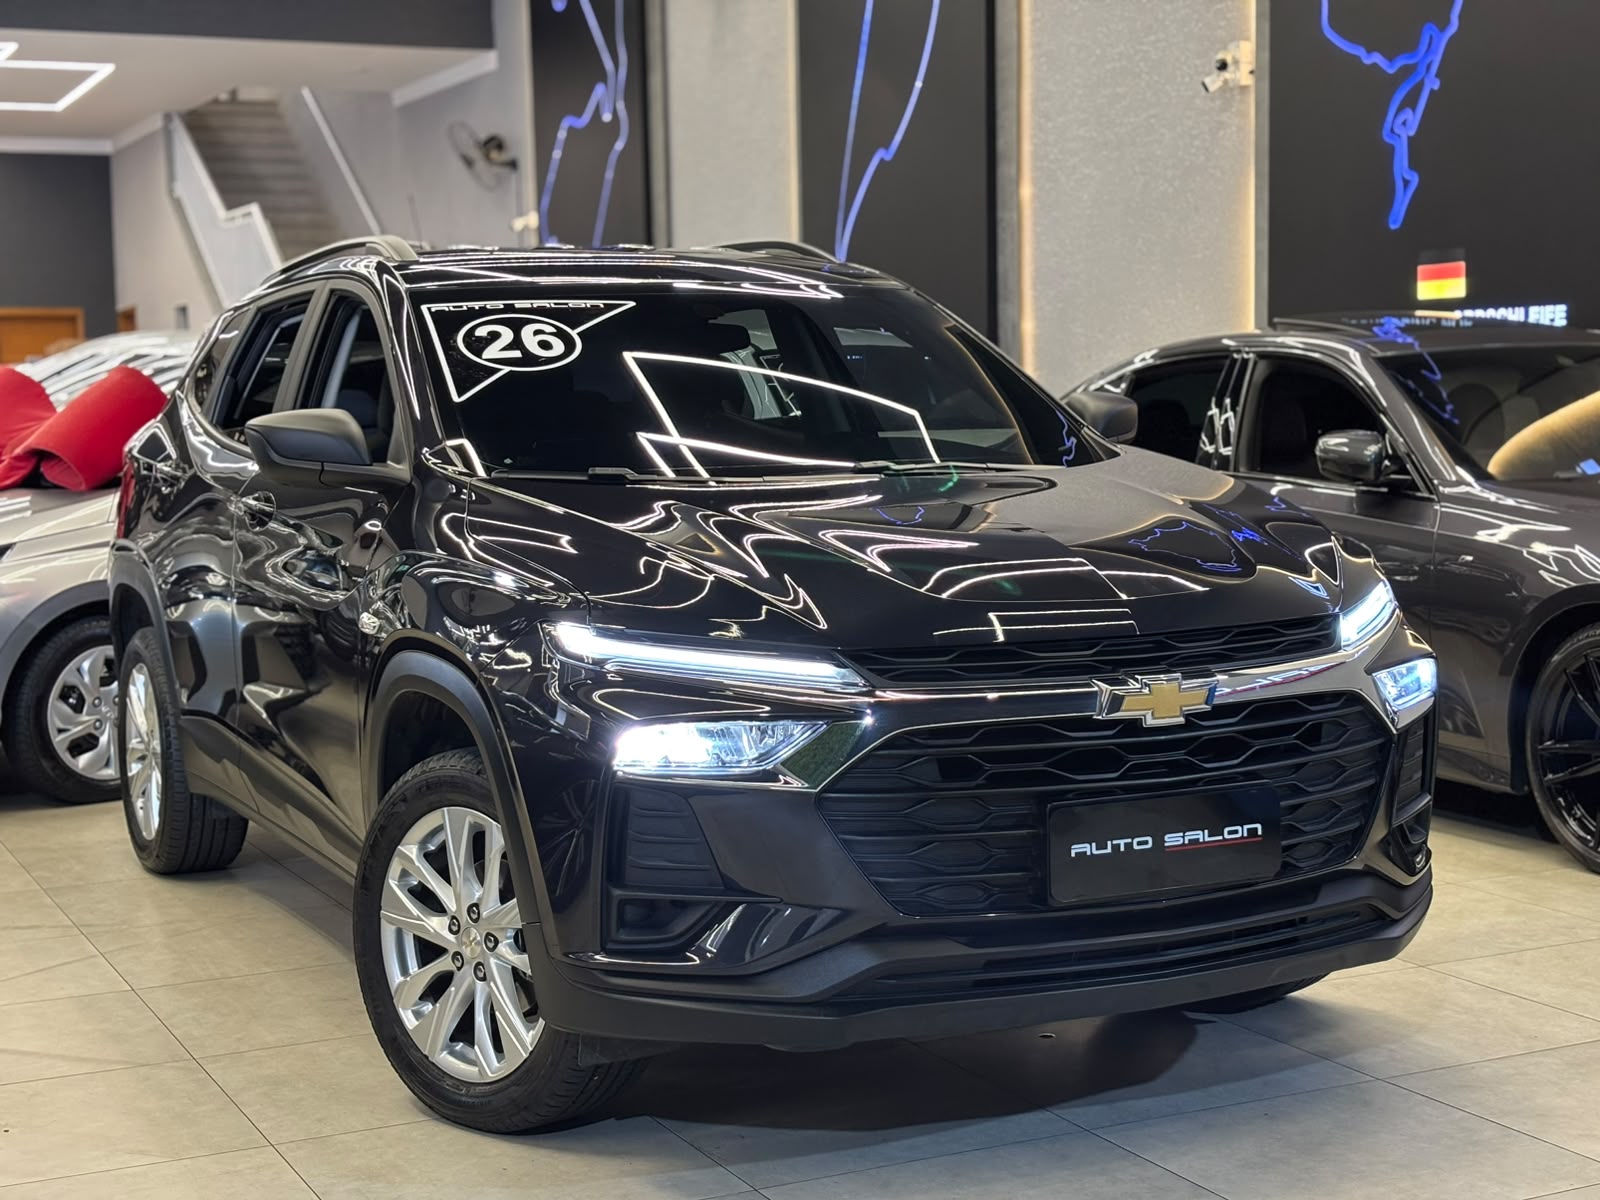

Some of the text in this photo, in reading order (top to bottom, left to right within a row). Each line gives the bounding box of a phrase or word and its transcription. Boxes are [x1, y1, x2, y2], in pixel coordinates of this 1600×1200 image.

[430, 303, 505, 312] AUTO
[474, 323, 566, 359] 26
[1070, 823, 1262, 857] AUTO SALON
